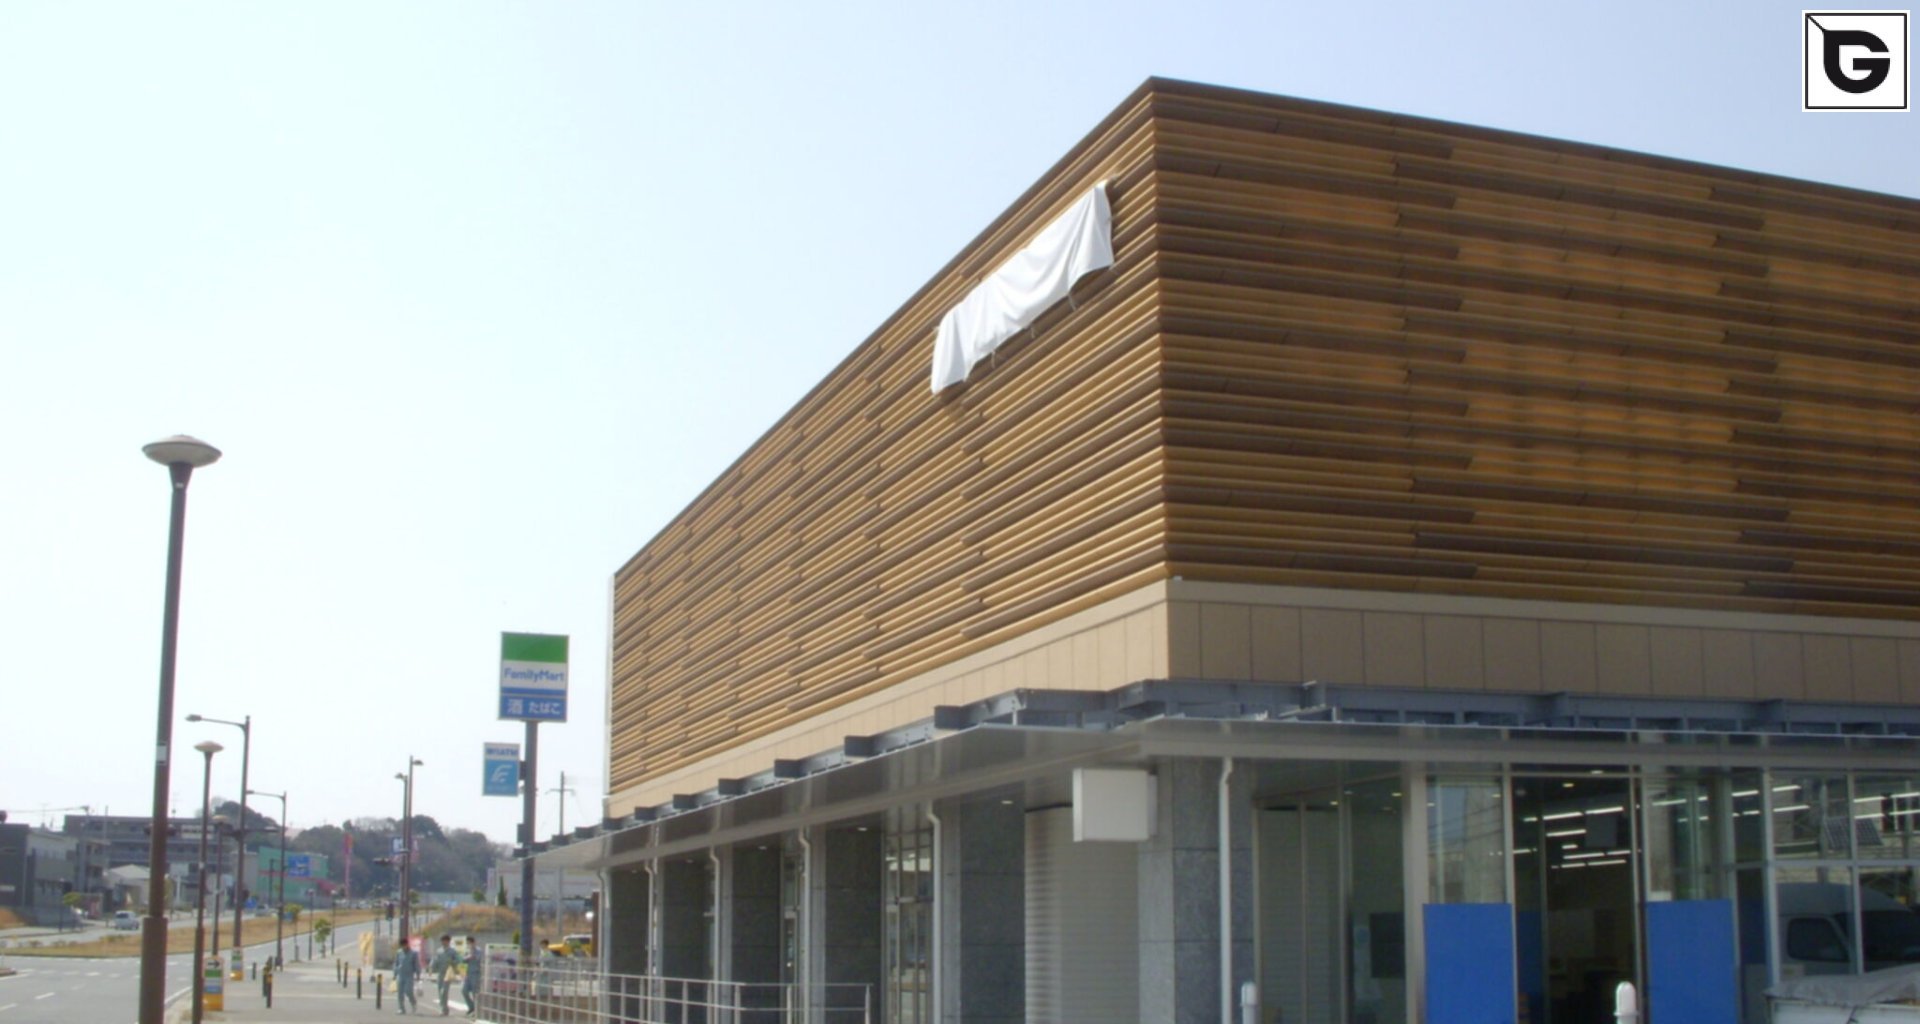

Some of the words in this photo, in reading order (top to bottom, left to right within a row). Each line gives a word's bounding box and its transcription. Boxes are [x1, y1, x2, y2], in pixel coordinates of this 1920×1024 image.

[504, 667, 564, 682] FamilyMart
[529, 702, 560, 715] たばこ
